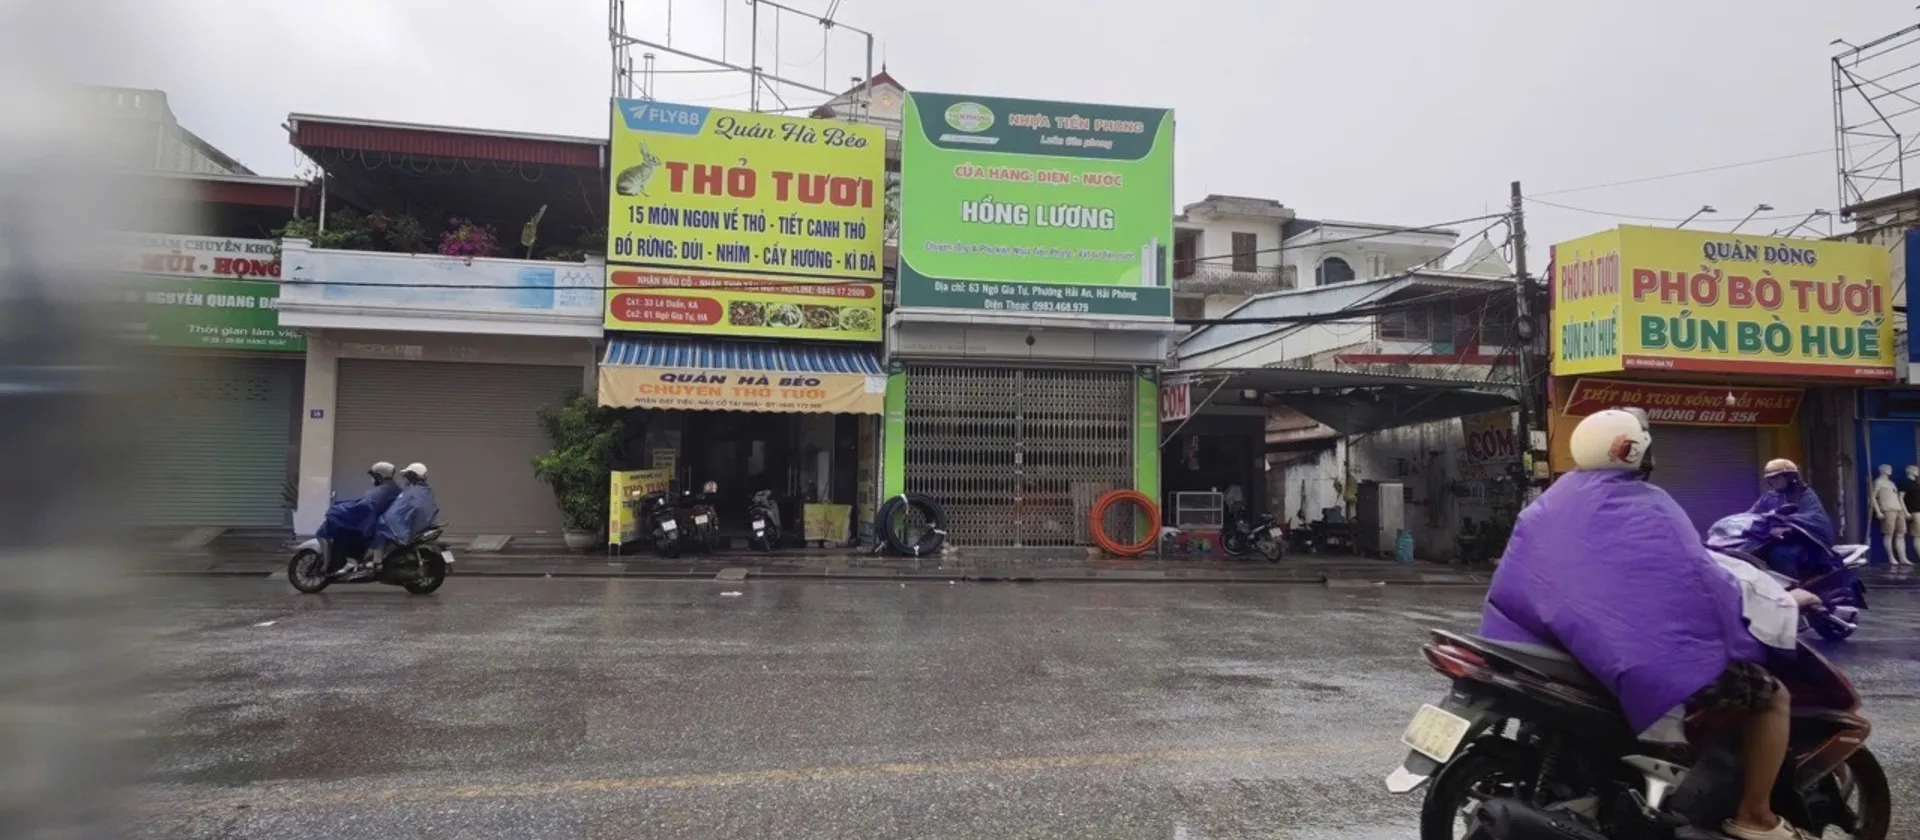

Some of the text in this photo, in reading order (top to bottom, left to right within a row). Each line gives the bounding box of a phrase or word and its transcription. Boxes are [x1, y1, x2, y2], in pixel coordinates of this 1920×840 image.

[648, 107, 700, 127] FLY88
[1008, 111, 1050, 131] NHỰA
[1094, 118, 1144, 134] PHONG
[715, 116, 868, 149] Quán Hà Béo
[955, 163, 985, 180] CỬA
[666, 158, 874, 208] THỎ TƯƠI
[629, 206, 644, 223] 15
[648, 204, 679, 227] MÓN
[683, 209, 719, 230] NGON
[743, 208, 766, 233] THỎ
[779, 212, 804, 236] TIẾT
[807, 219, 840, 240] CANH
[843, 216, 867, 240] THỎ
[961, 195, 1116, 231] HỒNG LƯƠNG
[184, 239, 242, 253] CHUYÊN
[637, 233, 678, 259] RỪNG:
[681, 237, 704, 261] DÚI
[716, 240, 751, 264] NHÍM
[791, 246, 833, 269] HƯƠNG
[859, 250, 877, 272] ĐÀ
[1703, 239, 1817, 267] QUÁN ĐÔNG
[141, 249, 196, 273] MŨI
[213, 257, 281, 280] HỌNG
[935, 281, 949, 293] Địa
[968, 283, 980, 294] 63
[982, 283, 999, 296] Ngô
[1001, 285, 1015, 295] Gia
[1032, 285, 1063, 299] Phường
[1065, 287, 1079, 298] Hải
[1096, 288, 1110, 299] Hải
[1111, 289, 1138, 302] Phòng
[1632, 264, 1884, 315] PHỞ BÒ TƯƠI
[206, 293, 255, 309] QUANG
[259, 296, 280, 311] ĐẠ
[984, 298, 1004, 311] Điện
[188, 324, 218, 335] Thời
[222, 326, 248, 338] gian
[251, 326, 274, 337] làm
[1641, 308, 1887, 361] BÚN BÒ HUẾ
[659, 371, 821, 388] QUÁN HÀ BÉO
[639, 382, 826, 401] CHUYÊN THỎ TƯƠI
[1620, 388, 1642, 403] BÒ
[1645, 390, 1681, 405] TƯƠI
[1648, 407, 1695, 422] MÓNG
[1698, 408, 1725, 423] GIÒ
[1729, 411, 1760, 424] 35K
